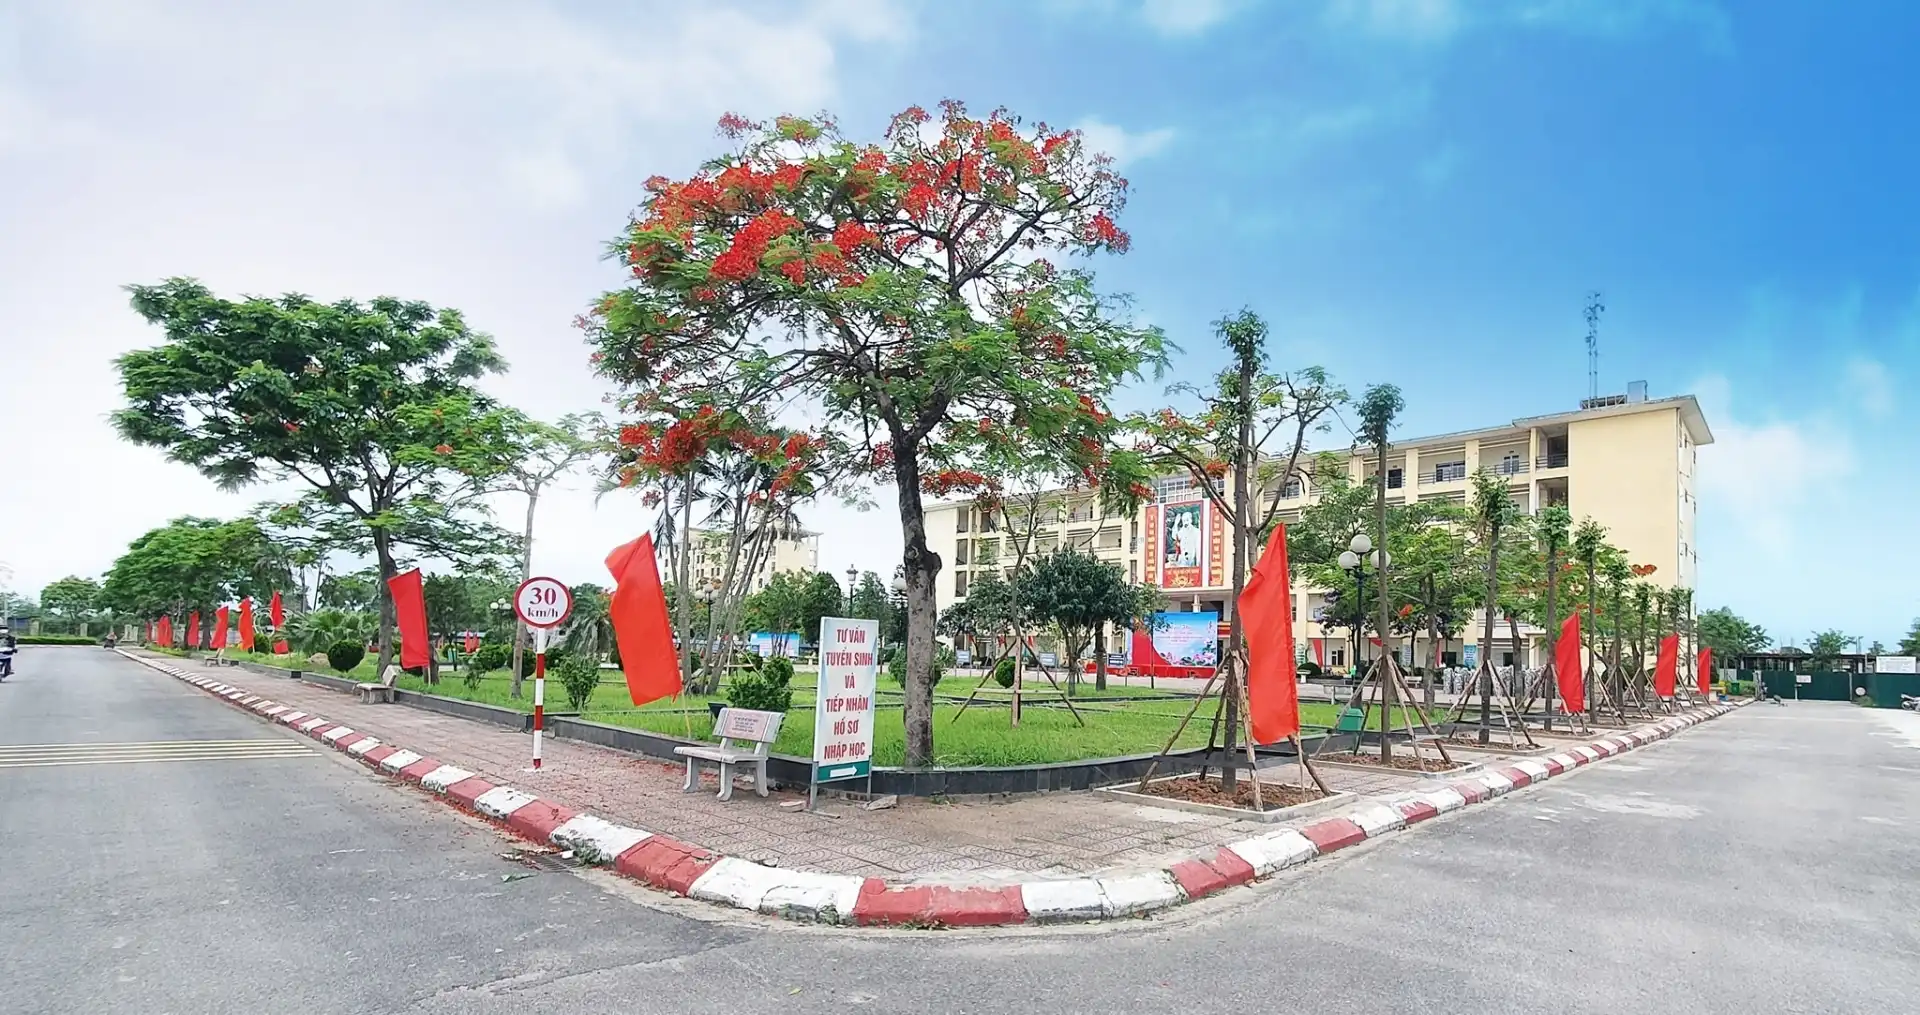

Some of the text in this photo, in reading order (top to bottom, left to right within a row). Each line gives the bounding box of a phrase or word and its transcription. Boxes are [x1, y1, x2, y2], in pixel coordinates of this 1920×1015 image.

[529, 587, 556, 605] 30
[527, 607, 559, 618] km/h
[837, 624, 865, 643] TƯ VẤN
[853, 652, 873, 666] SINH
[826, 693, 868, 714] TIẾP NHẬN
[847, 719, 859, 735] SƠ
[824, 741, 866, 761] NHẬP HỌC
